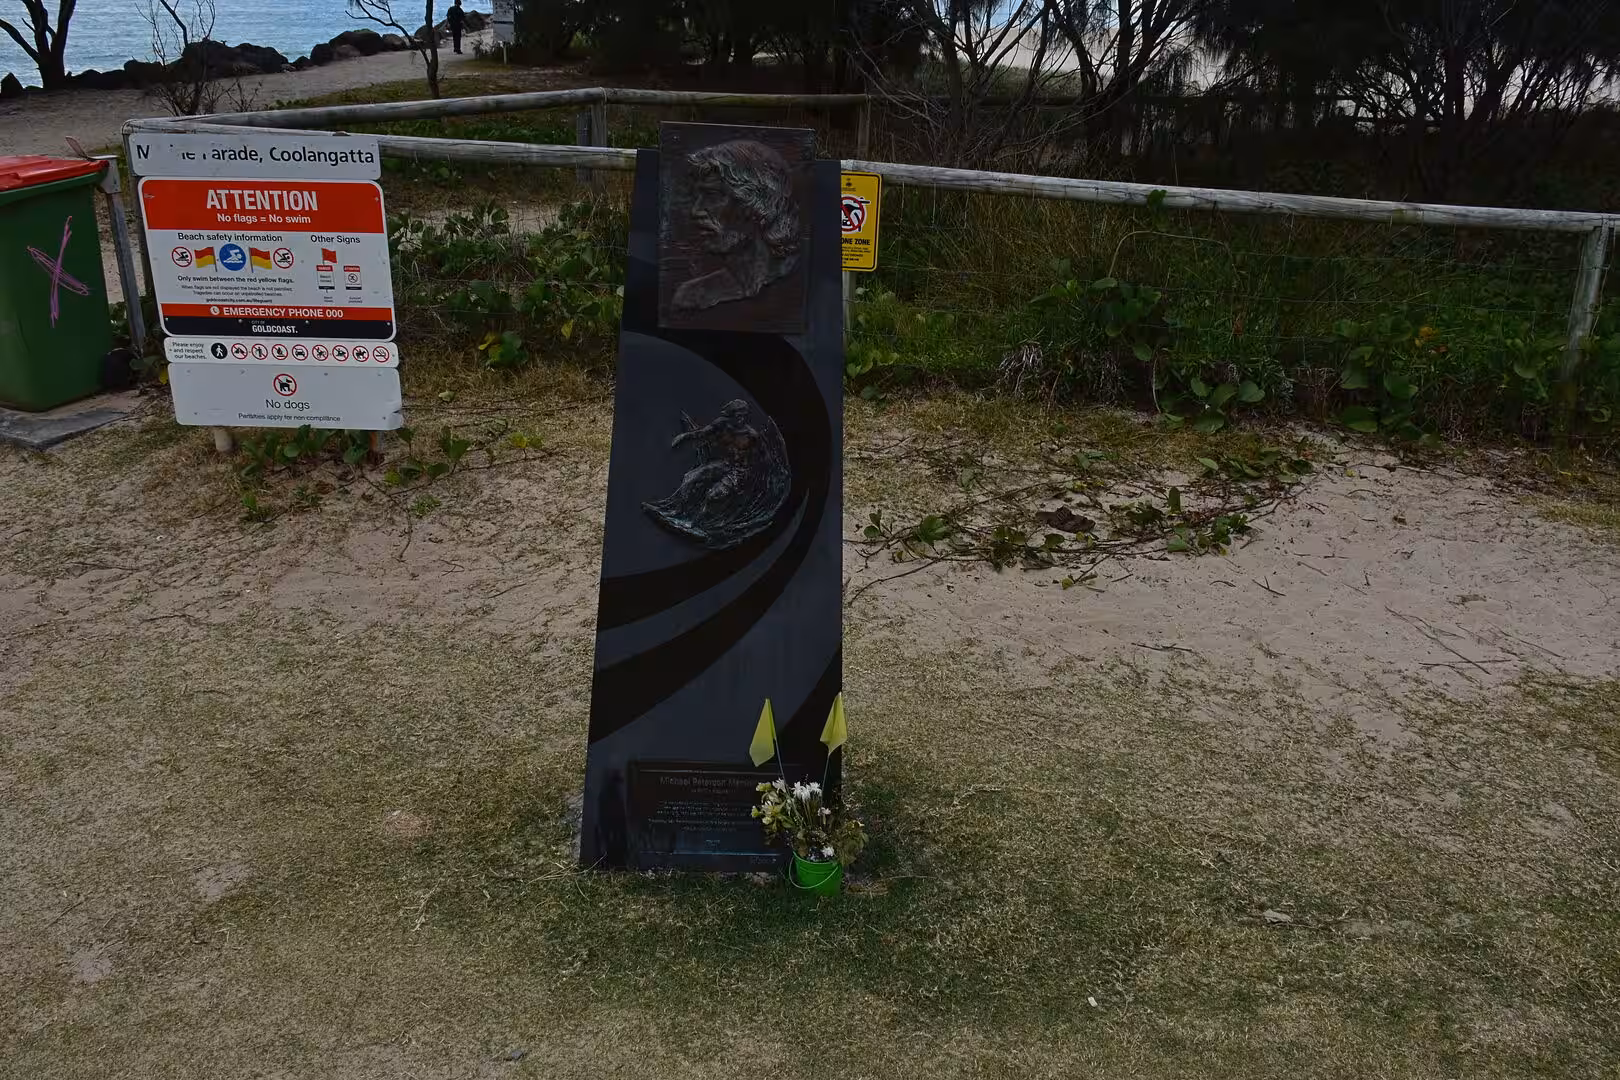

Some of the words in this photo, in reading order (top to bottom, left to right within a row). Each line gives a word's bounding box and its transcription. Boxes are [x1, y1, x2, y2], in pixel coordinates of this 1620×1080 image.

[269, 146, 375, 167] Coolangatta
[206, 189, 318, 211] ATTENTION
[217, 213, 231, 222] No
[233, 213, 258, 224] flags
[269, 214, 283, 223] No
[285, 215, 311, 224] swim
[177, 232, 205, 241] Beach
[206, 233, 232, 242] safety
[234, 233, 283, 242] information
[310, 234, 335, 243] Other
[336, 235, 361, 245] Signs
[854, 238, 871, 246] ZONE
[222, 307, 286, 317] EMERGENCY
[288, 308, 324, 318] PHONE
[325, 309, 344, 319] 000
[265, 399, 281, 409] No
[284, 399, 310, 411] dogs
